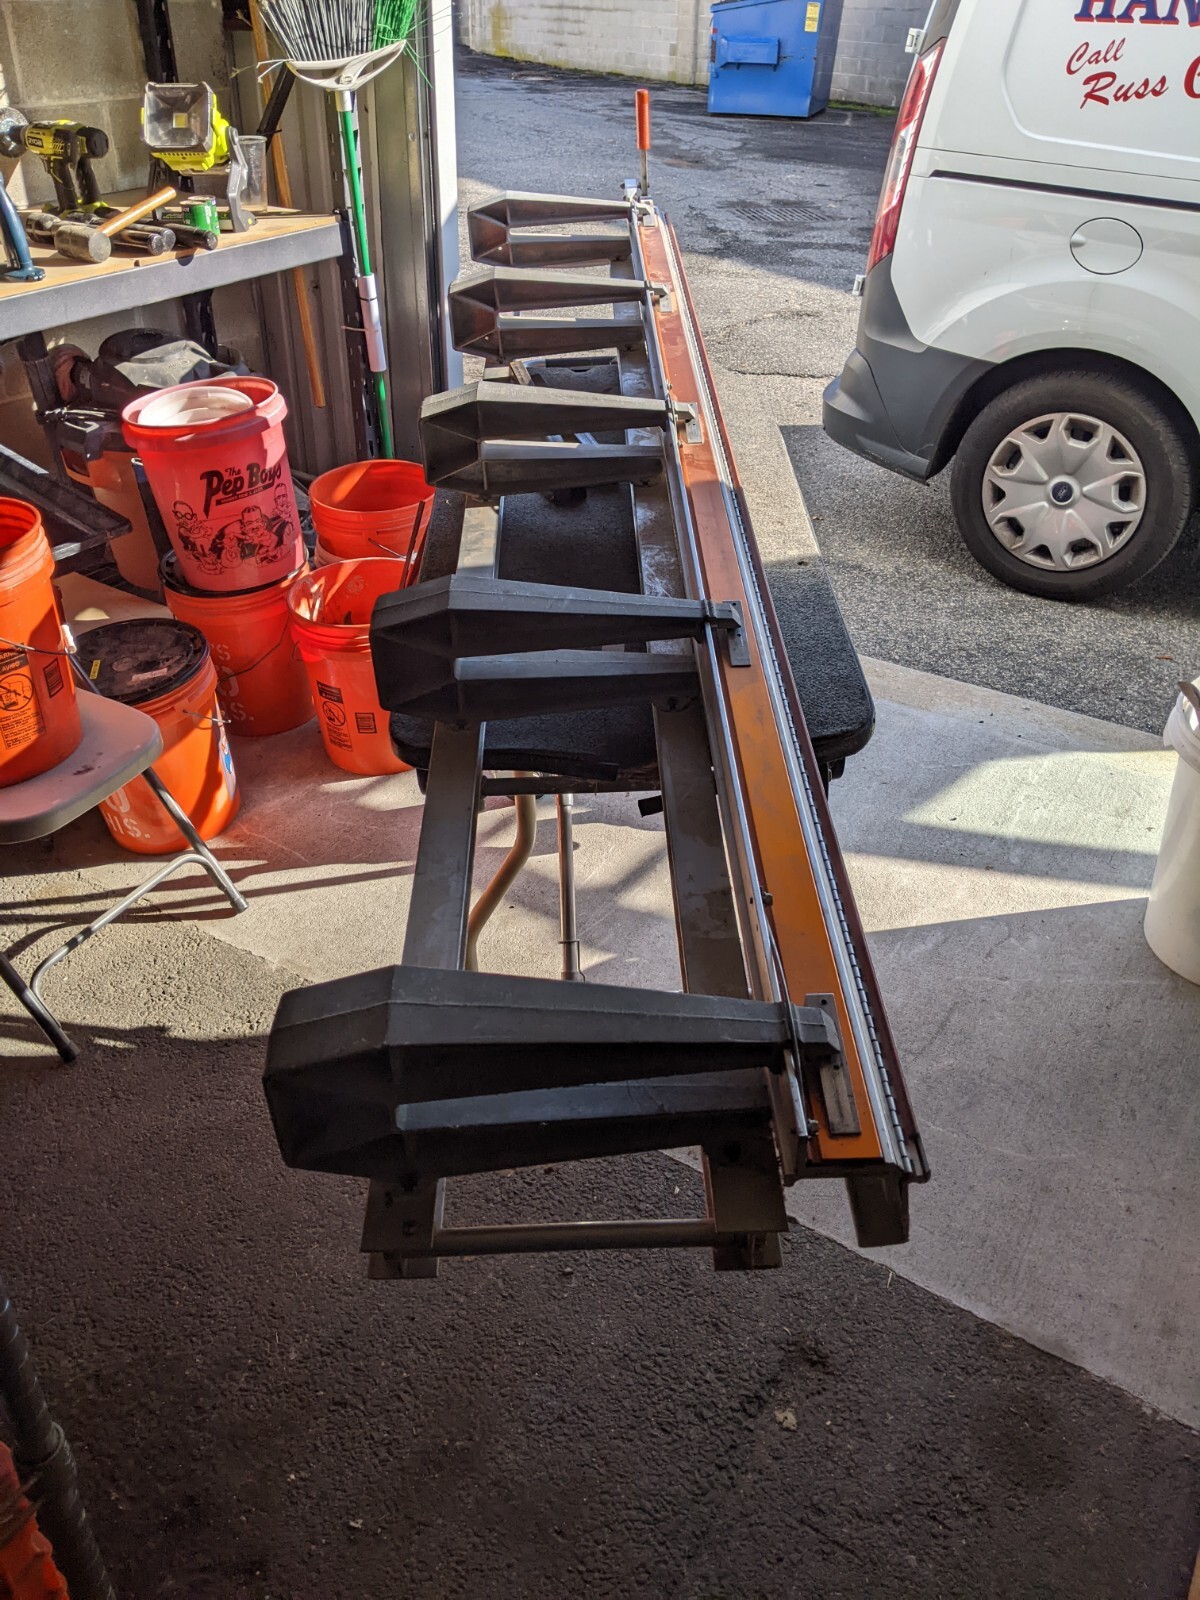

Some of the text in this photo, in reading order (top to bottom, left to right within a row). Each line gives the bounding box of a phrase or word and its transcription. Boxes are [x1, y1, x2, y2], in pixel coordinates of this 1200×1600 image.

[1066, 37, 1126, 75] Call
[1080, 71, 1169, 109] Russ
[225, 467, 241, 476] The
[200, 470, 244, 519] Pep
[247, 463, 281, 488] Boys
